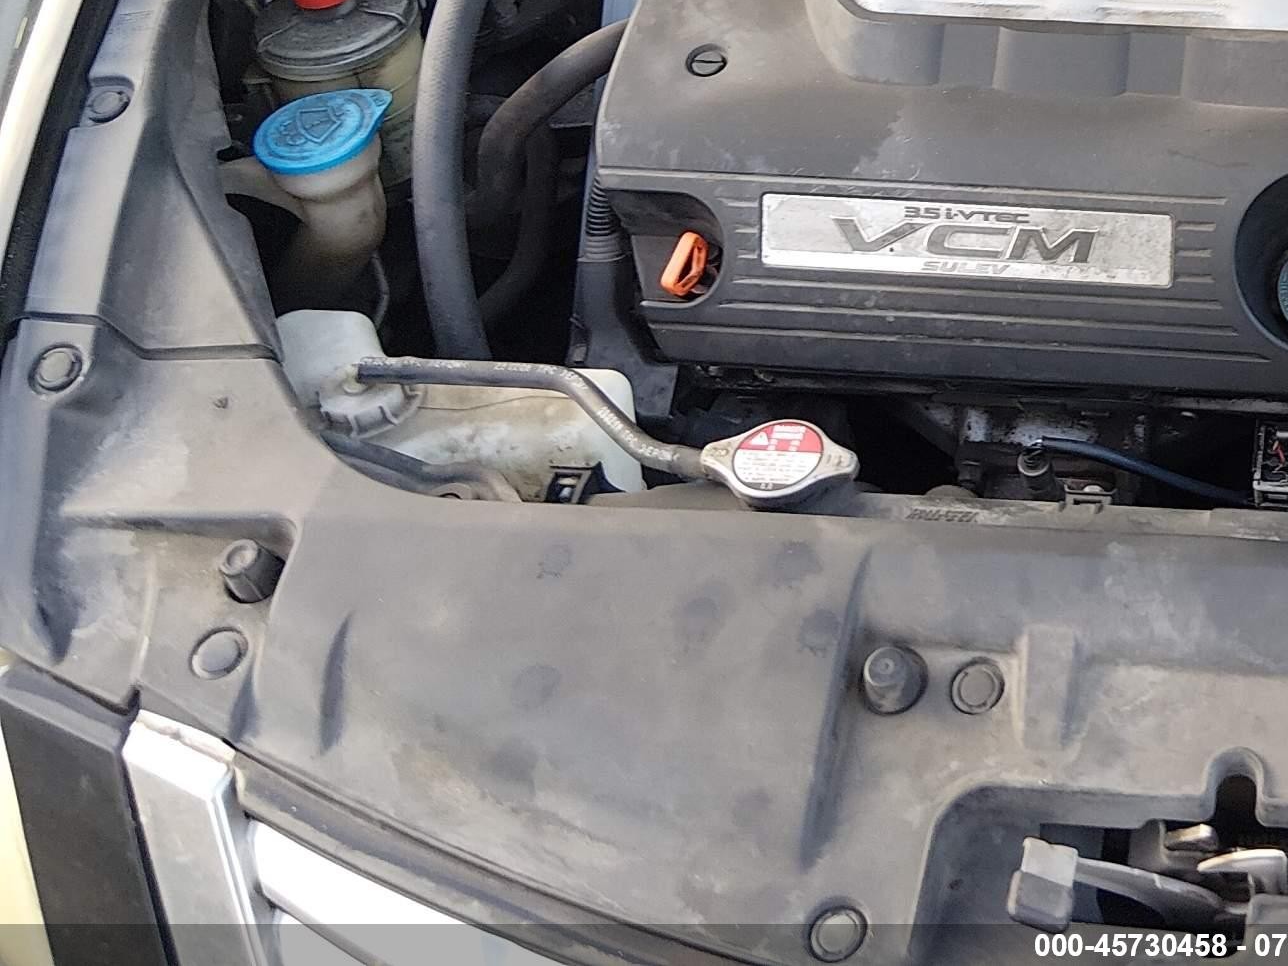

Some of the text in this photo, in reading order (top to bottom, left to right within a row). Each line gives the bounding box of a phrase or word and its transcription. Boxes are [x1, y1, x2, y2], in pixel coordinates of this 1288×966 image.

[945, 208, 1030, 224] i-VTEC
[830, 215, 1099, 264] VCM
[921, 260, 1011, 275] SULEV
